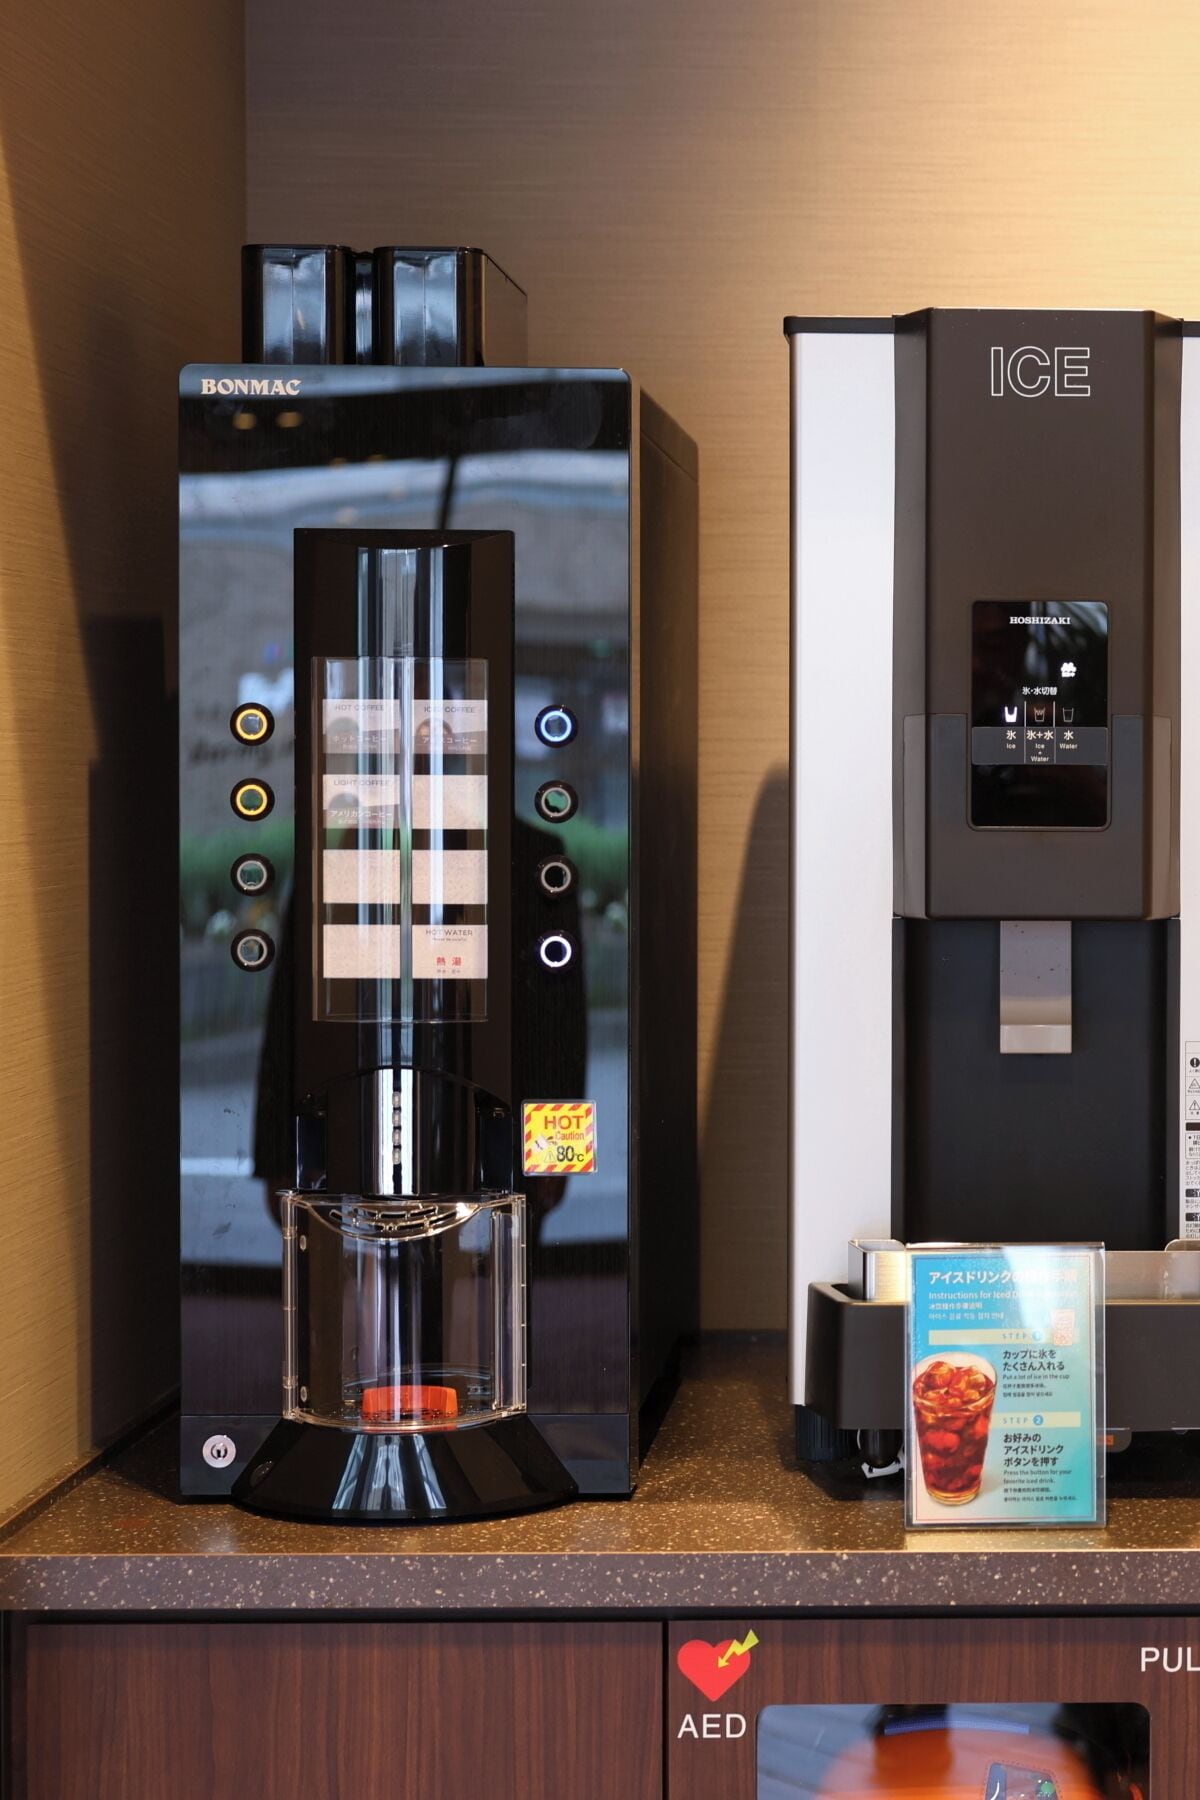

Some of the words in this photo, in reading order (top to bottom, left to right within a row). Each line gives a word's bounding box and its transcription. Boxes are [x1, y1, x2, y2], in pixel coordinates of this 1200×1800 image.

[991, 346, 1091, 398] ICE
[200, 379, 302, 396] BONMAC
[1010, 616, 1071, 625] HOSHIZAKI
[1006, 730, 1017, 740] 氷
[1063, 730, 1074, 740] 水
[544, 1115, 584, 1130] HOT
[555, 1131, 584, 1140] Caution
[928, 1291, 977, 1300] Instructions
[980, 1290, 991, 1299] for
[1003, 1332, 1028, 1340] STEP
[1003, 1349, 1057, 1360] カップに氷を
[1003, 1361, 1065, 1372] たくさん入れる
[1004, 1433, 1041, 1443] お好みの
[1004, 1444, 1064, 1455] アイスドリンク
[1004, 1457, 1059, 1467] ボタンを押す
[677, 1713, 747, 1739] AED
